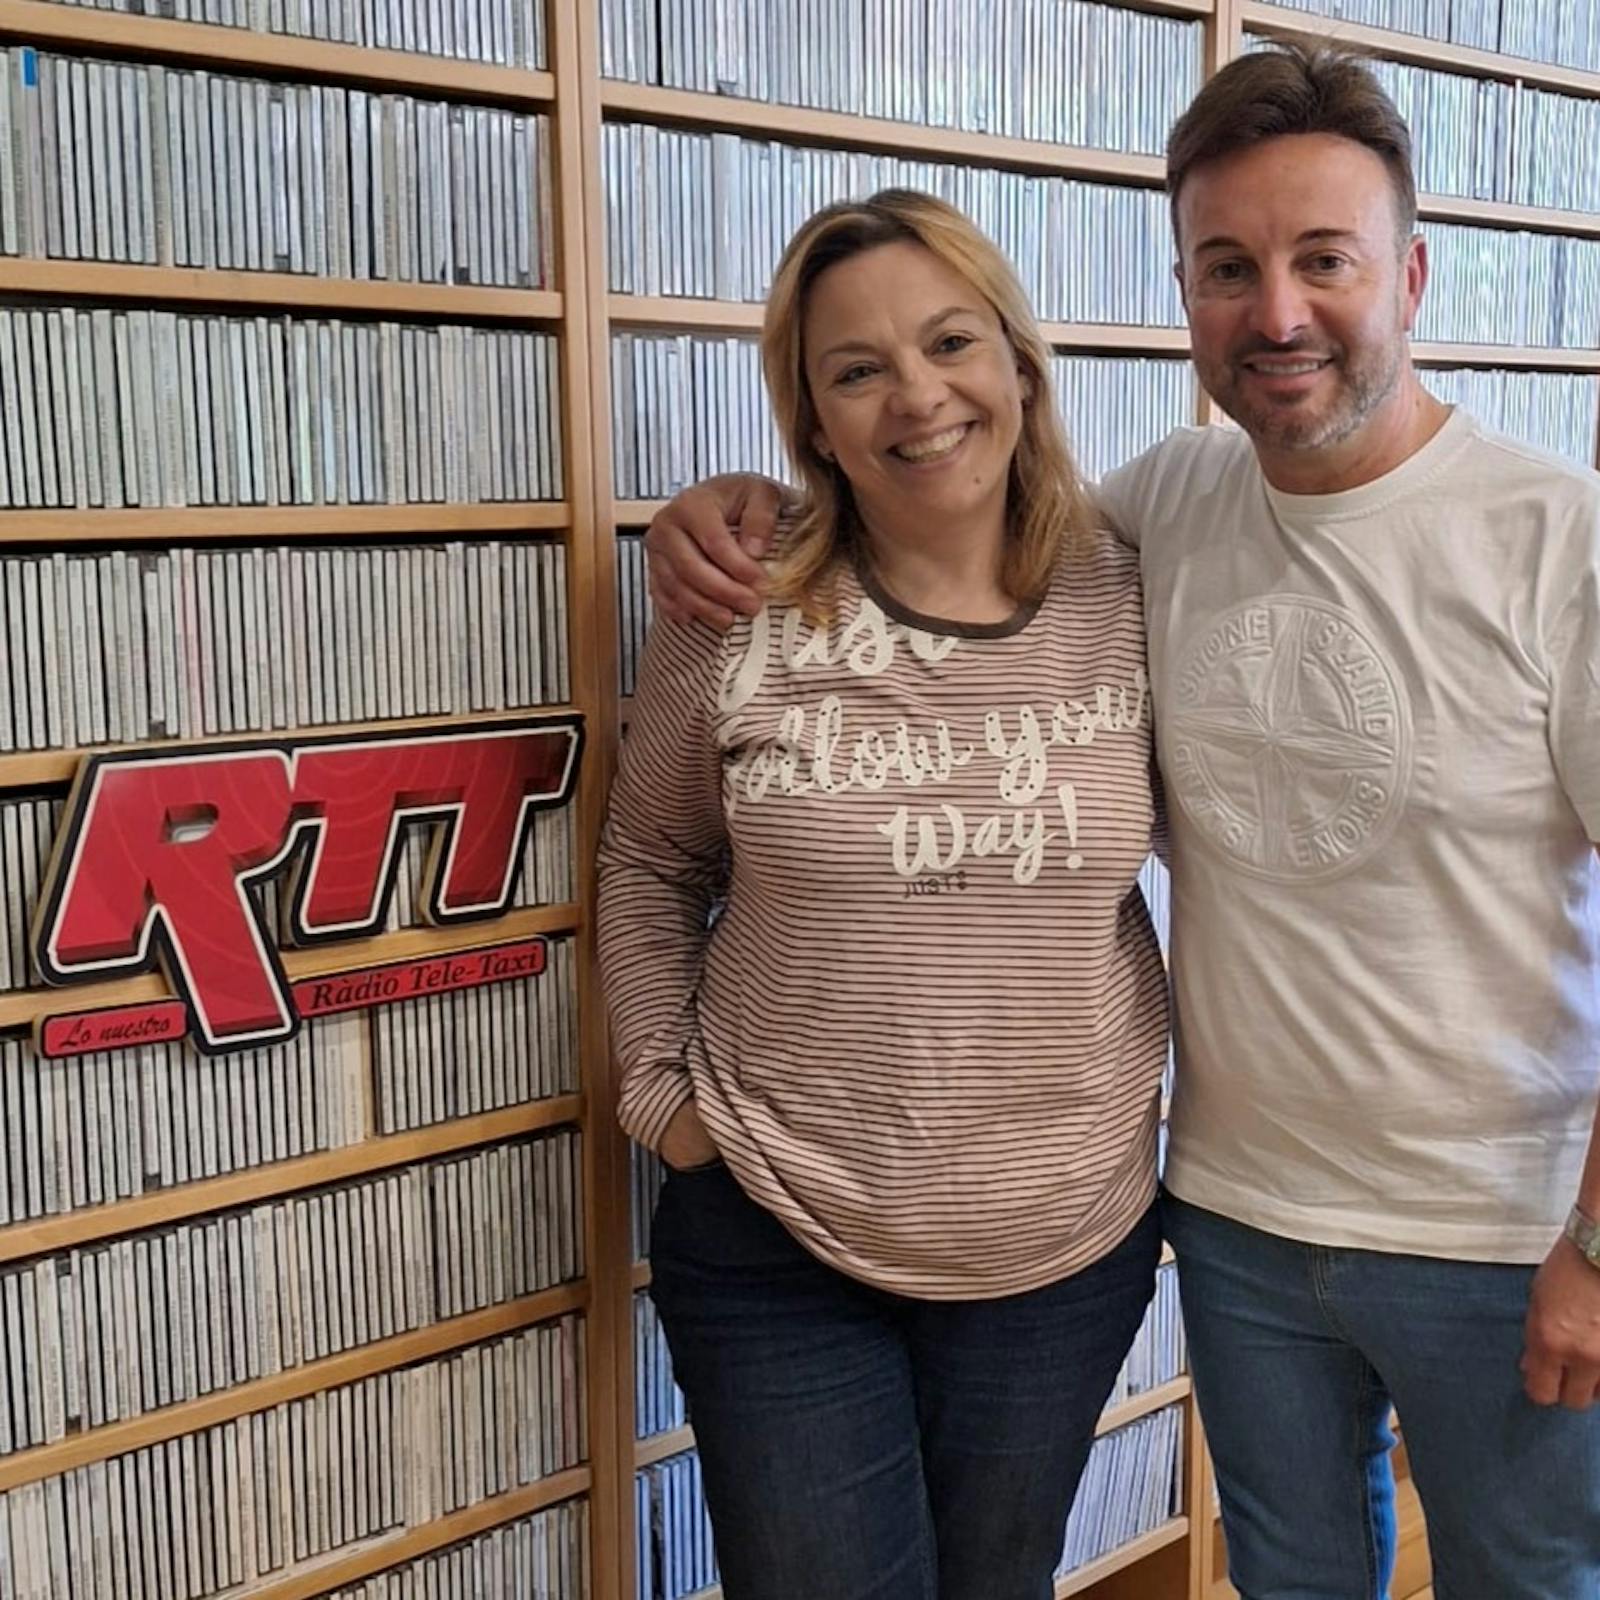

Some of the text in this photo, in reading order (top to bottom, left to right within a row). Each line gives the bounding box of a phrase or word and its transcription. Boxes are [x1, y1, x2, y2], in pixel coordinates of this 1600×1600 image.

[877, 784, 1083, 885] Way!
[50, 728, 578, 1042] RTT
[309, 945, 539, 1010] Ràdio Tele-Taxi
[59, 1015, 171, 1048] Lo nuestro
